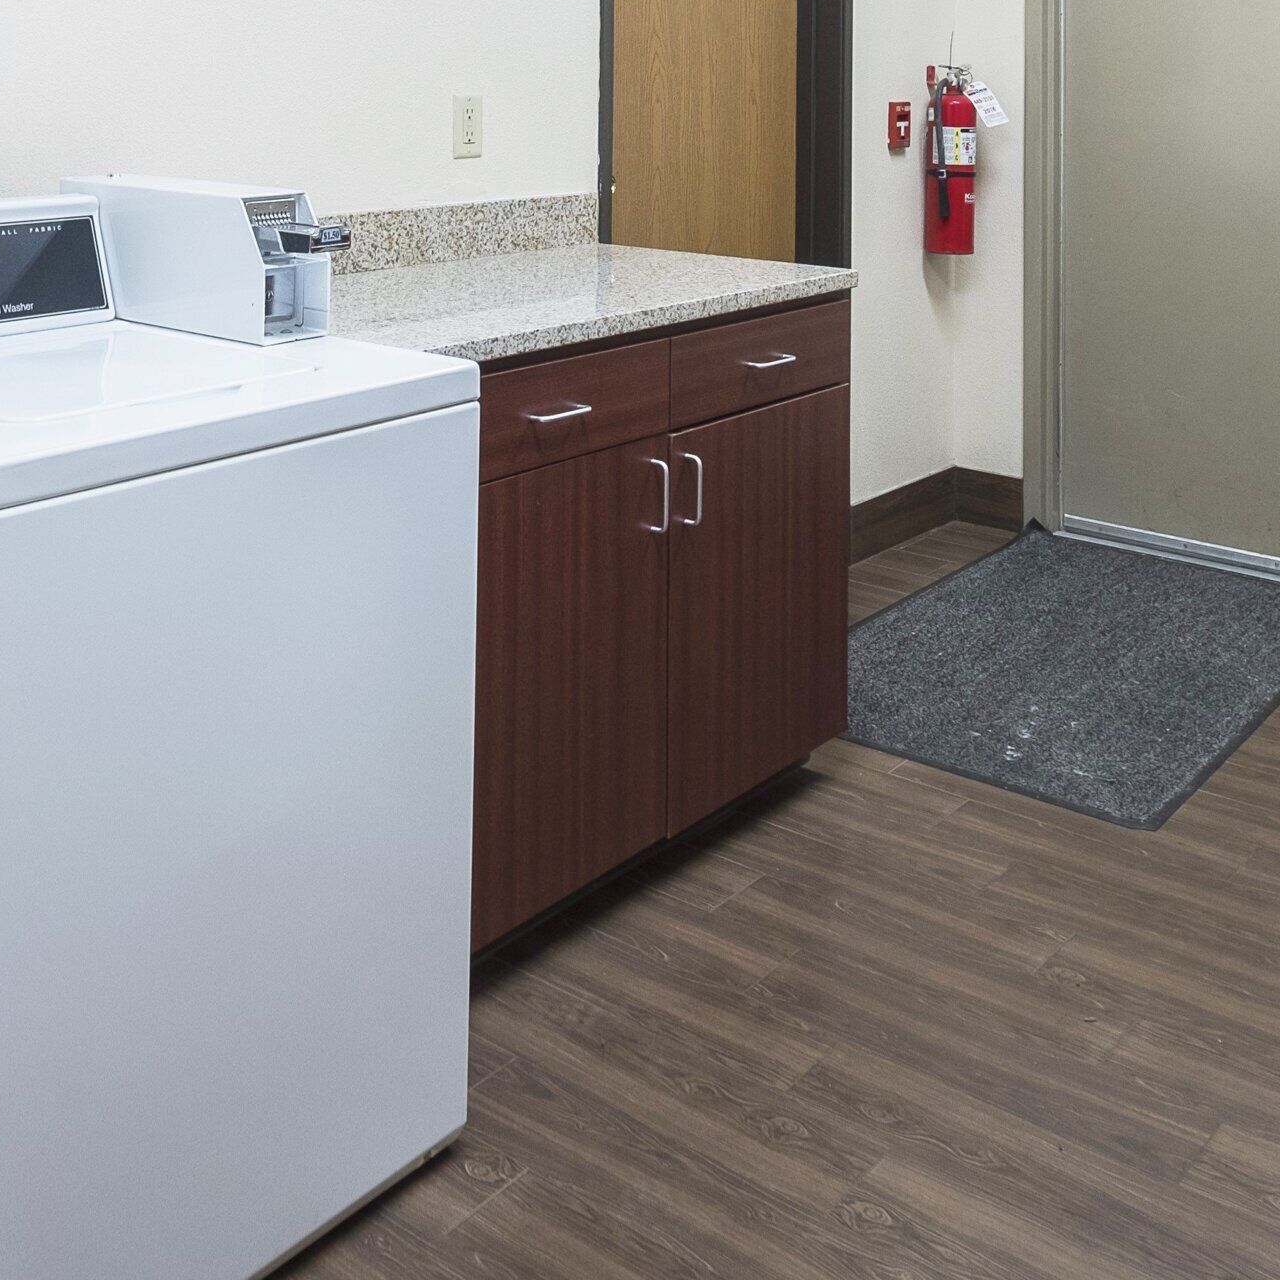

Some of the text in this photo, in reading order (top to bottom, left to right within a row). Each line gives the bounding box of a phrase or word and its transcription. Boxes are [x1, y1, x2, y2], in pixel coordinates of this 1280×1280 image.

[29, 224, 63, 233] FABRIC
[323, 230, 340, 241] $1.50
[2, 301, 35, 314] Washer
